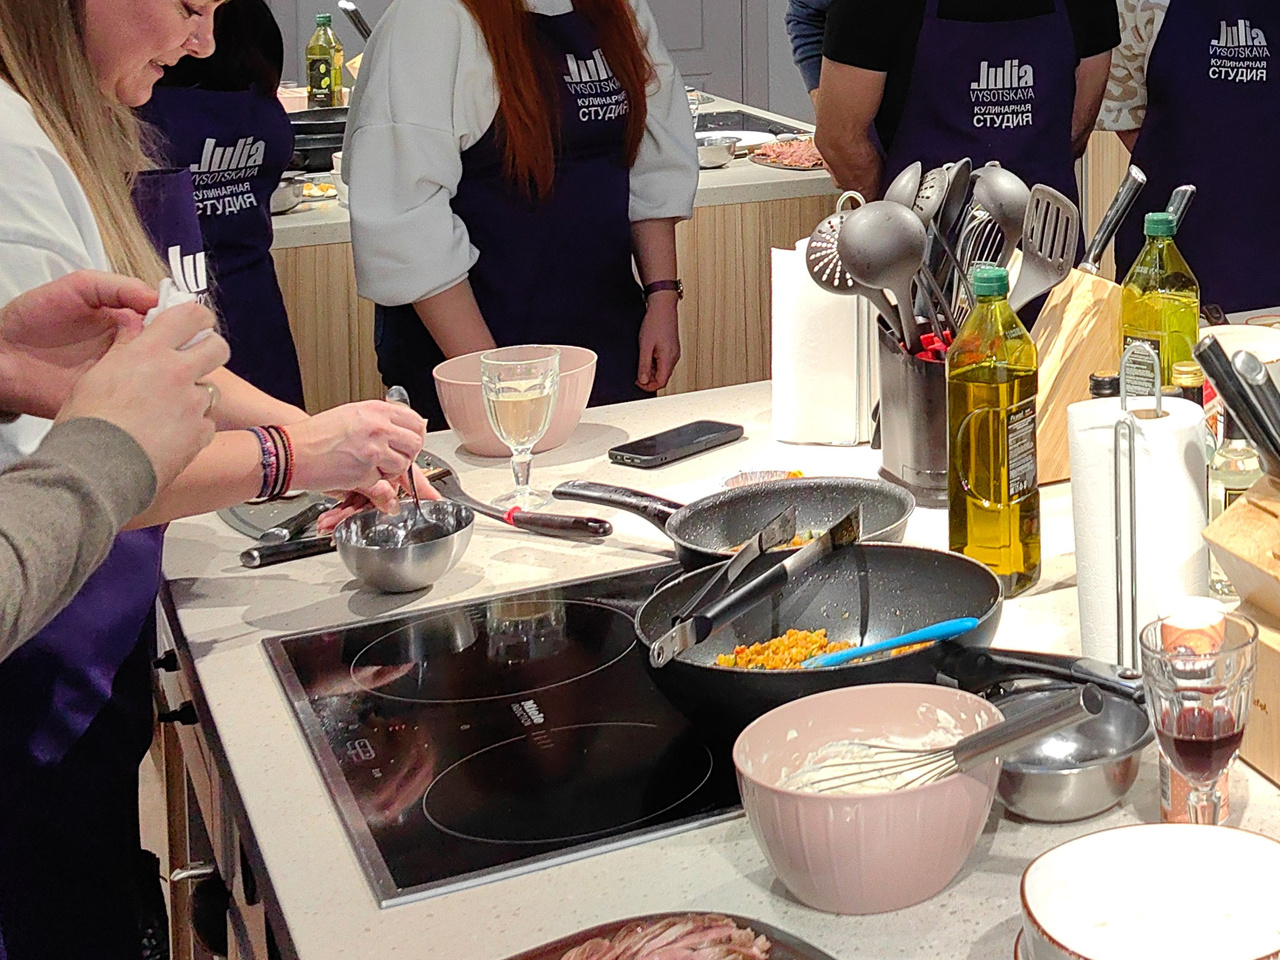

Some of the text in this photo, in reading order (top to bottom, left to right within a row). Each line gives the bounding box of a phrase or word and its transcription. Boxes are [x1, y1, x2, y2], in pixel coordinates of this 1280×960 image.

[1210, 19, 1267, 47] Julia
[1209, 46, 1271, 58] VYSOTSKAYA
[563, 48, 613, 83] Juli
[1210, 58, 1267, 68] КУЛИНАРНАЯ
[970, 59, 1034, 89] Julia
[1209, 67, 1267, 83] СТУДИЯ
[970, 88, 1035, 102] VYSOTSKAYA
[579, 101, 629, 121] СТУДИЯ
[974, 104, 1032, 114] КУЛИНАРНАЯ
[973, 113, 1032, 129] СТУДИЯ
[189, 136, 265, 173] Julia
[195, 193, 258, 215] СТУДИЯ
[521, 699, 545, 725] Miele
